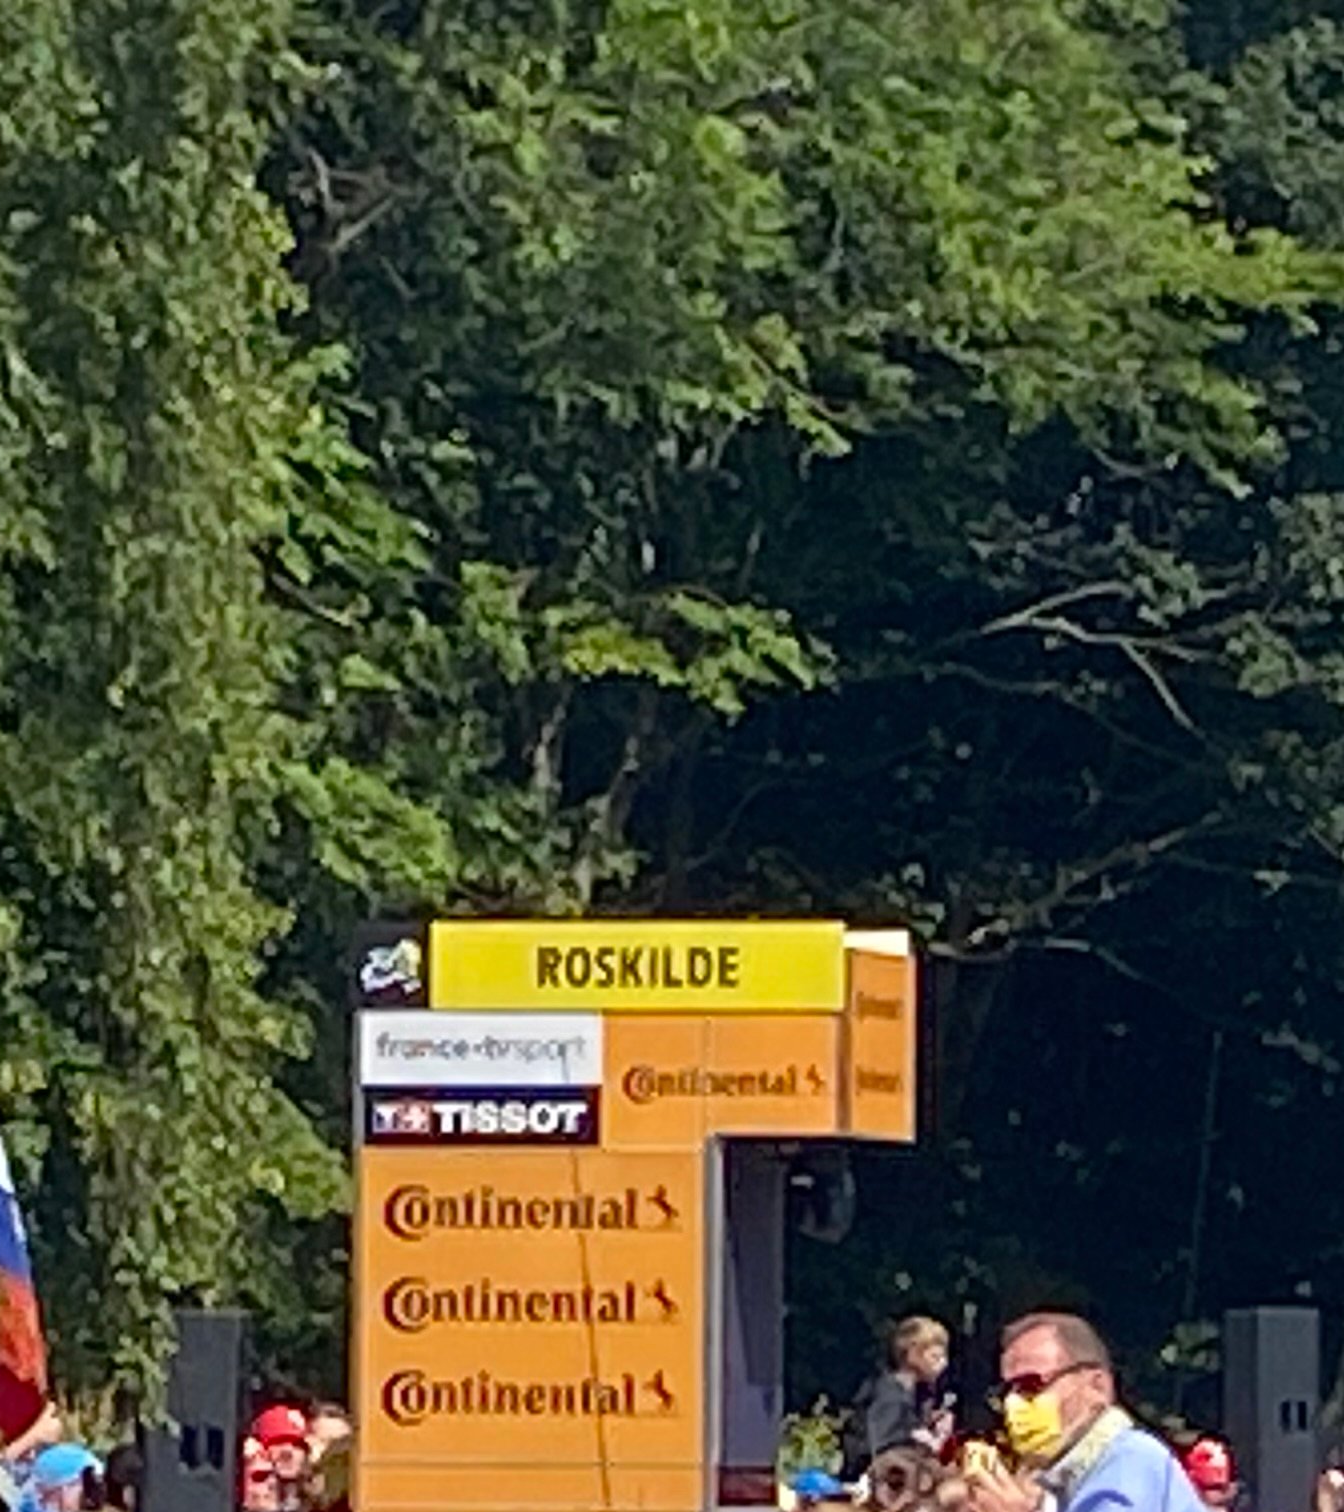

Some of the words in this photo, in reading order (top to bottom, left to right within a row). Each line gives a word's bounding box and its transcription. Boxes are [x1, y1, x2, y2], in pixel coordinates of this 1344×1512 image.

[536, 946, 740, 988] ROSKILDE
[433, 1101, 588, 1135] TISSOT
[384, 1184, 638, 1241] Continental
[384, 1276, 637, 1334] Continental
[382, 1368, 636, 1426] Continental
